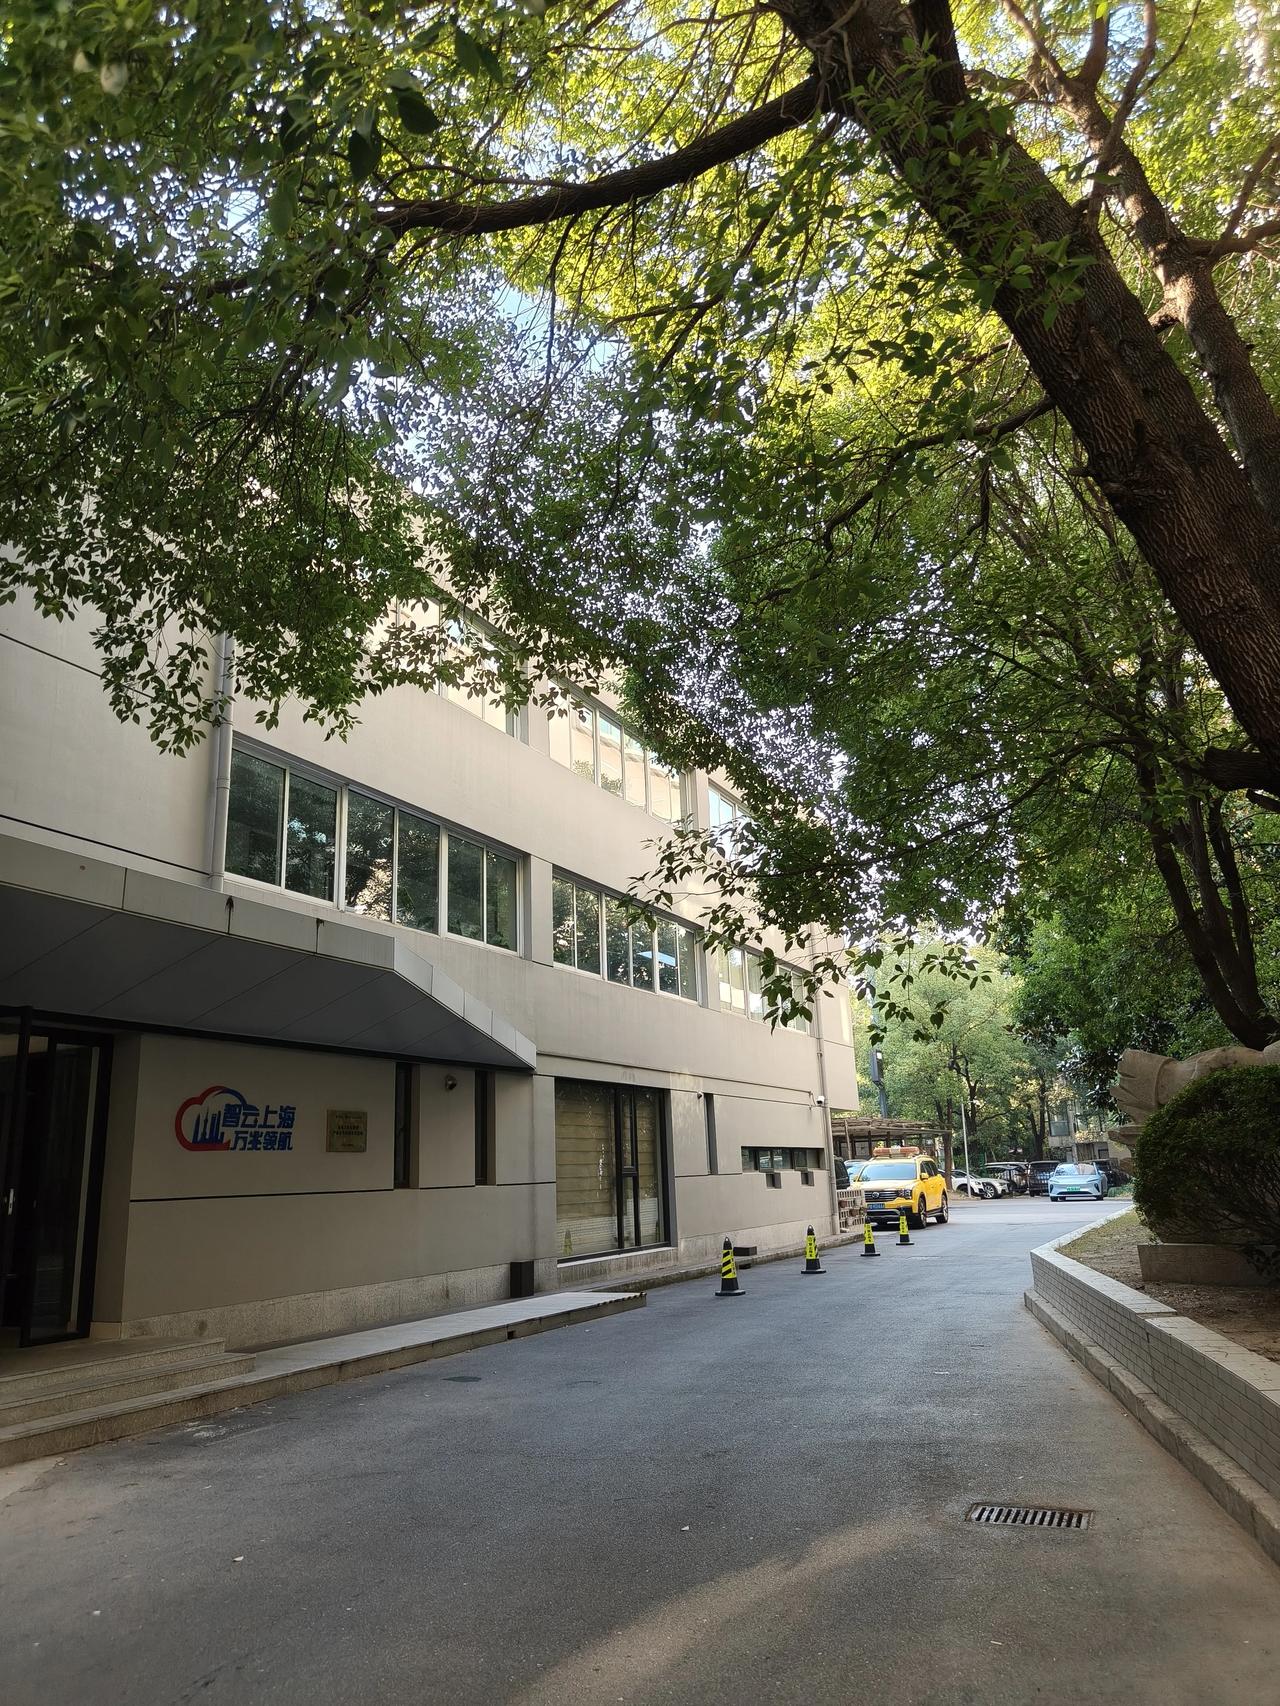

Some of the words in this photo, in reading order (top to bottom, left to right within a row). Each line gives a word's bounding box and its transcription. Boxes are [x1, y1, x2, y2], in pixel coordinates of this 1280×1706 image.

[222, 1104, 296, 1128] 智云上海
[230, 1131, 293, 1151] 万兆领航
